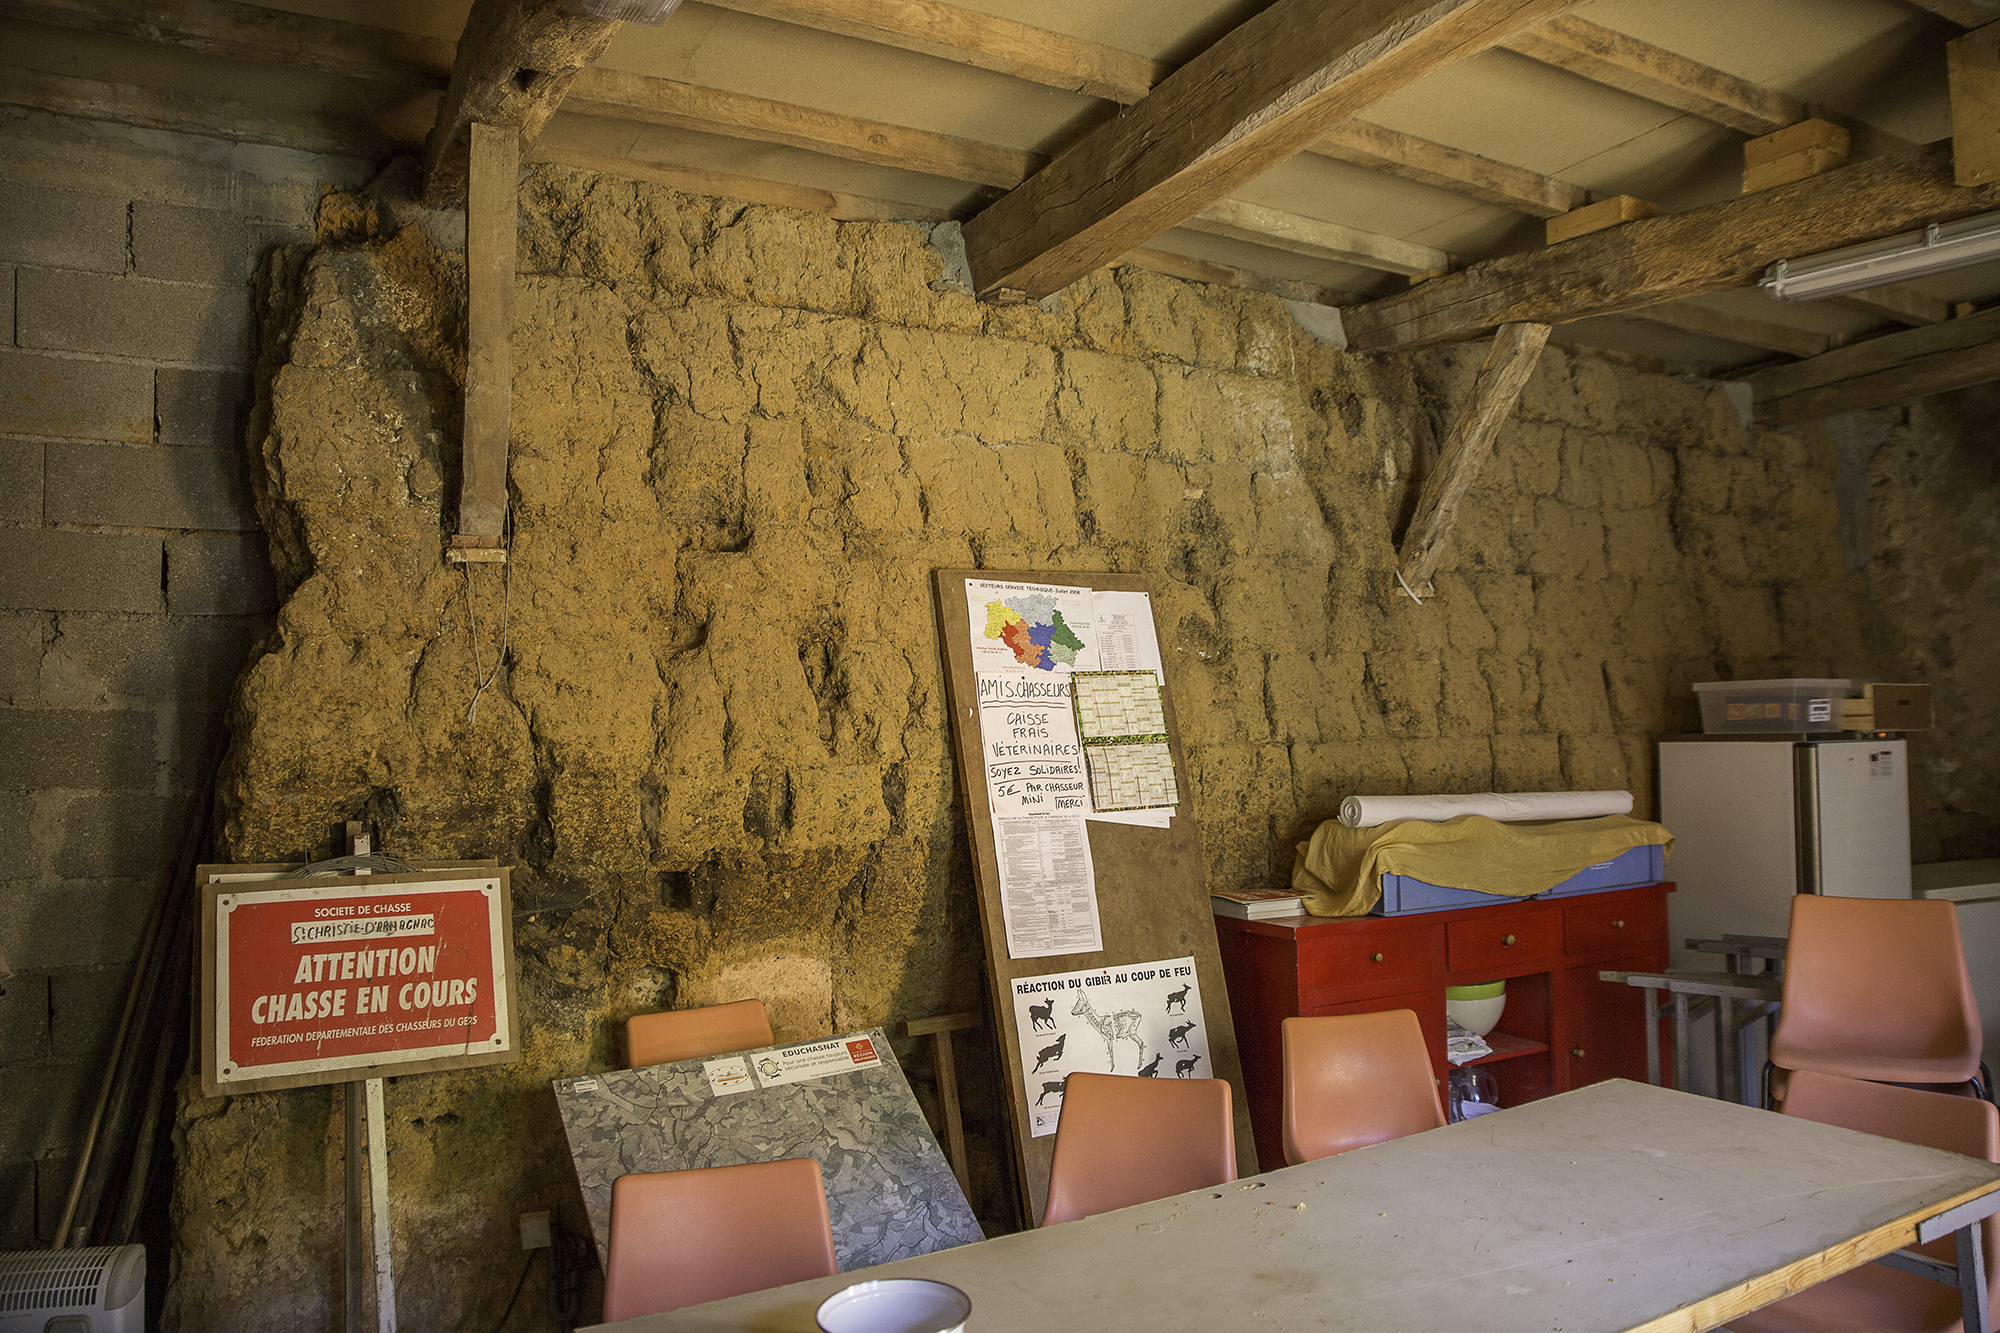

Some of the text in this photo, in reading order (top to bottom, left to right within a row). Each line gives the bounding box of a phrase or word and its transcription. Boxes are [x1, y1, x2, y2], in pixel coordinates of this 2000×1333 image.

[1025, 782, 1043, 793] PAR
[1044, 781, 1085, 793] CHASSEUR
[314, 902, 412, 918] SOCIETE DE CHASSE
[294, 945, 436, 984] ATTENTION
[1016, 966, 1192, 995] RÉACTION DU GIBIER AU COUP DE FEU
[251, 977, 478, 1025] CHASSE EN COURS
[251, 1015, 478, 1048] FEDERATION DEPARTEMENTALE DES CHASSEURS DU GERS
[782, 1041, 841, 1058] EDUCHASNAT
[807, 1055, 824, 1063] chasse
[825, 1050, 848, 1059] toujours
[818, 1055, 849, 1066] responsable
